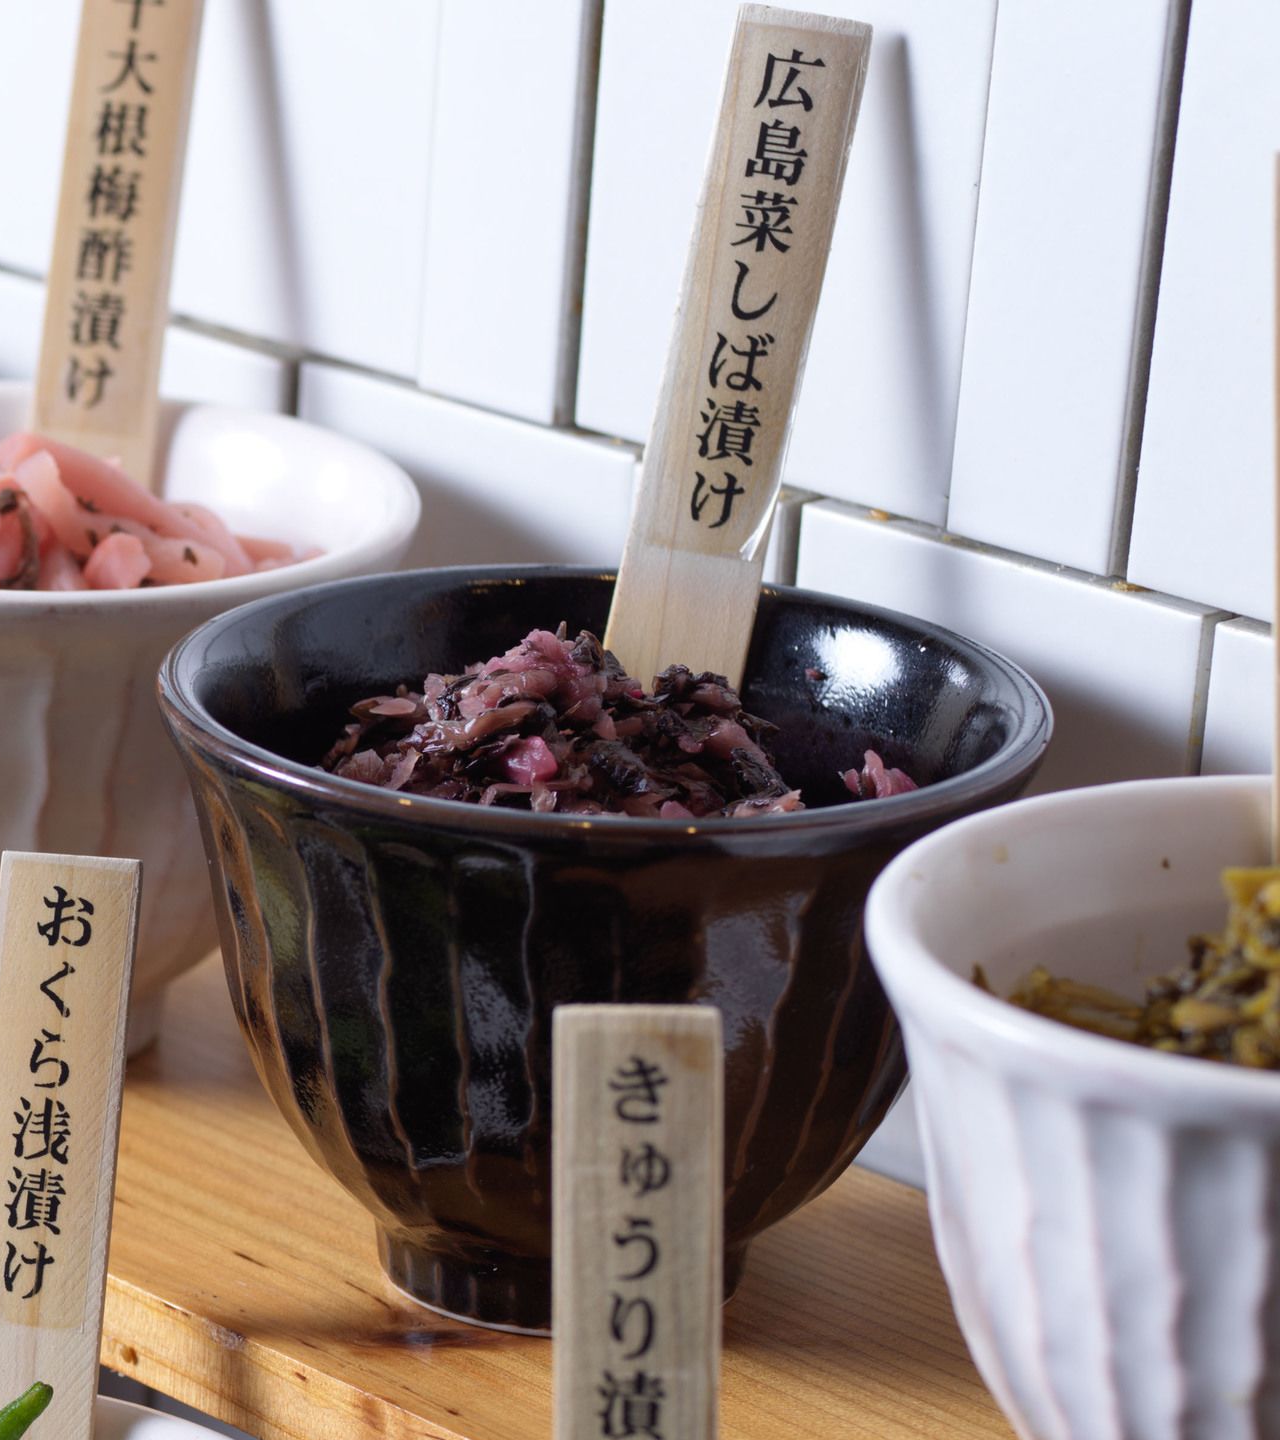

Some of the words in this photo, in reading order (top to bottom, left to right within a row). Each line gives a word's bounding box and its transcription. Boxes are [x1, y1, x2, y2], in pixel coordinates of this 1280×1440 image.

[689, 48, 827, 529] 広島菜しば漬け
[3, 884, 96, 1300] おくら浅漬け
